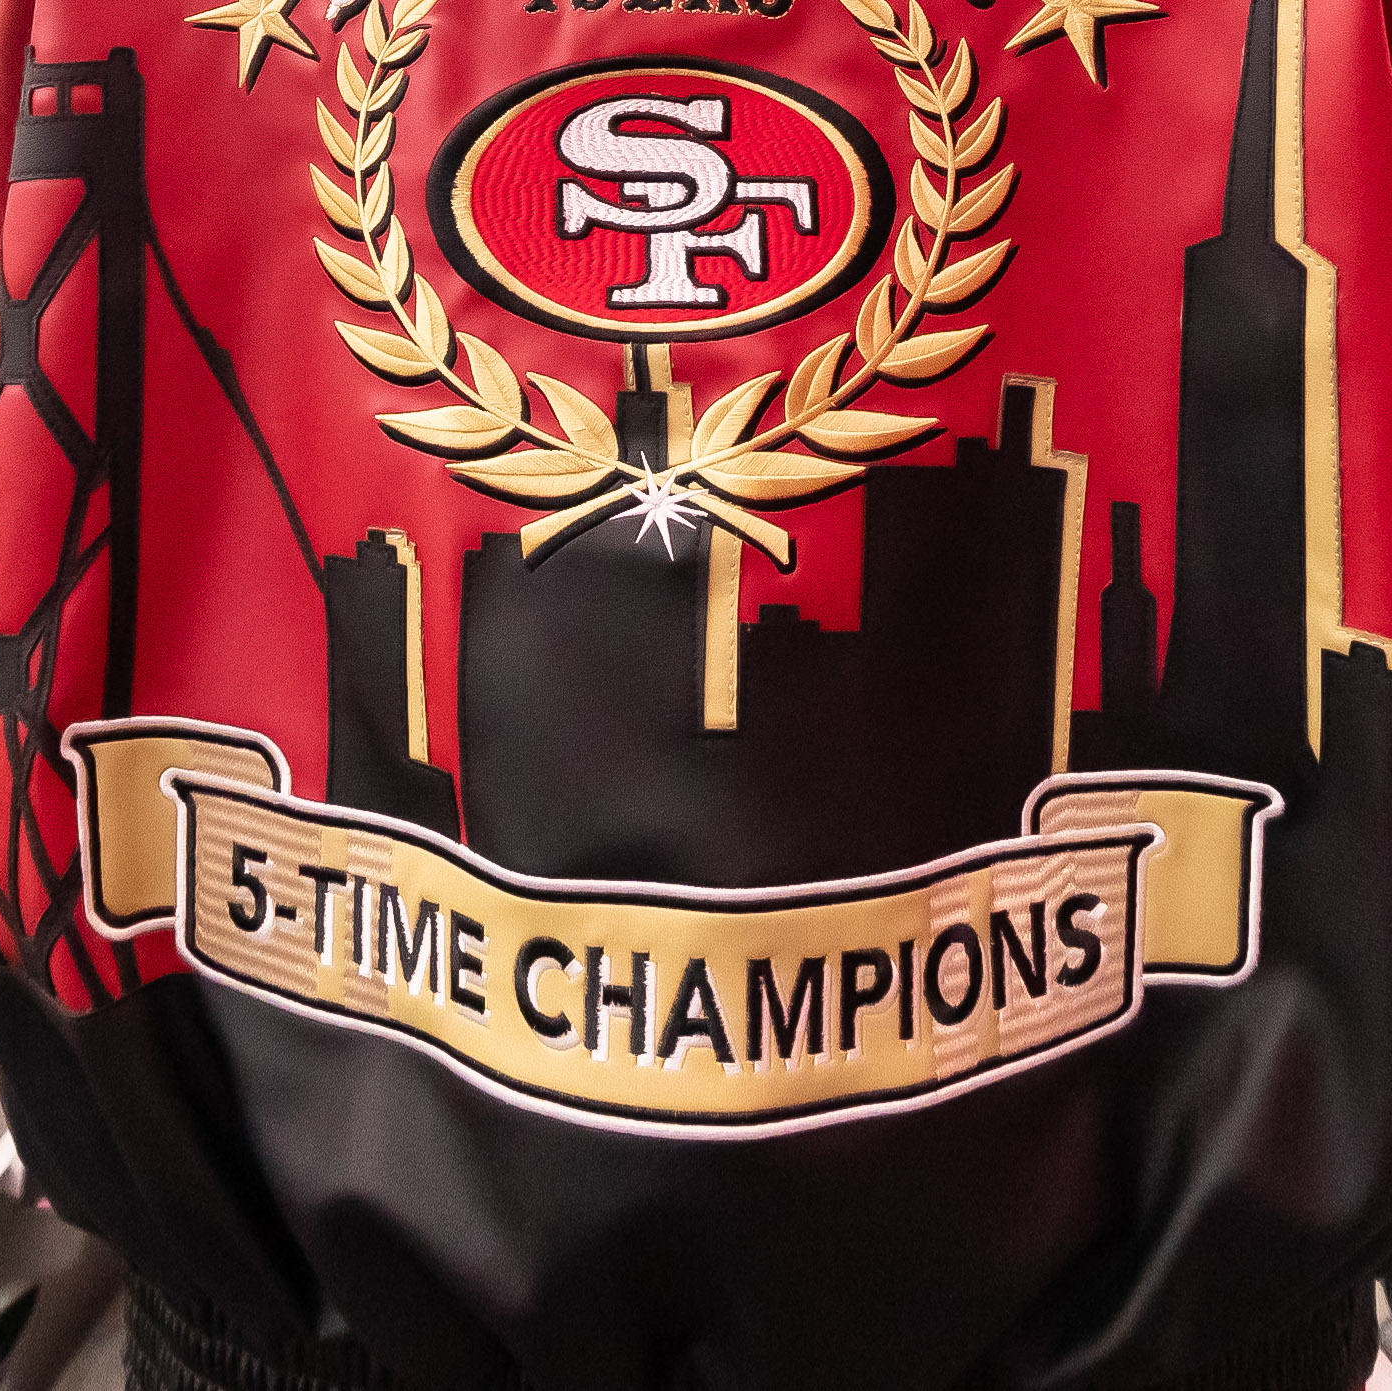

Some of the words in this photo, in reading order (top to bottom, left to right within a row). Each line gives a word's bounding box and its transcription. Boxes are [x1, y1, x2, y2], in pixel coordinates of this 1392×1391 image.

[555, 93, 820, 309] SF
[225, 842, 493, 1020] 5-TIME
[513, 891, 1108, 1076] CHAMPIONS
